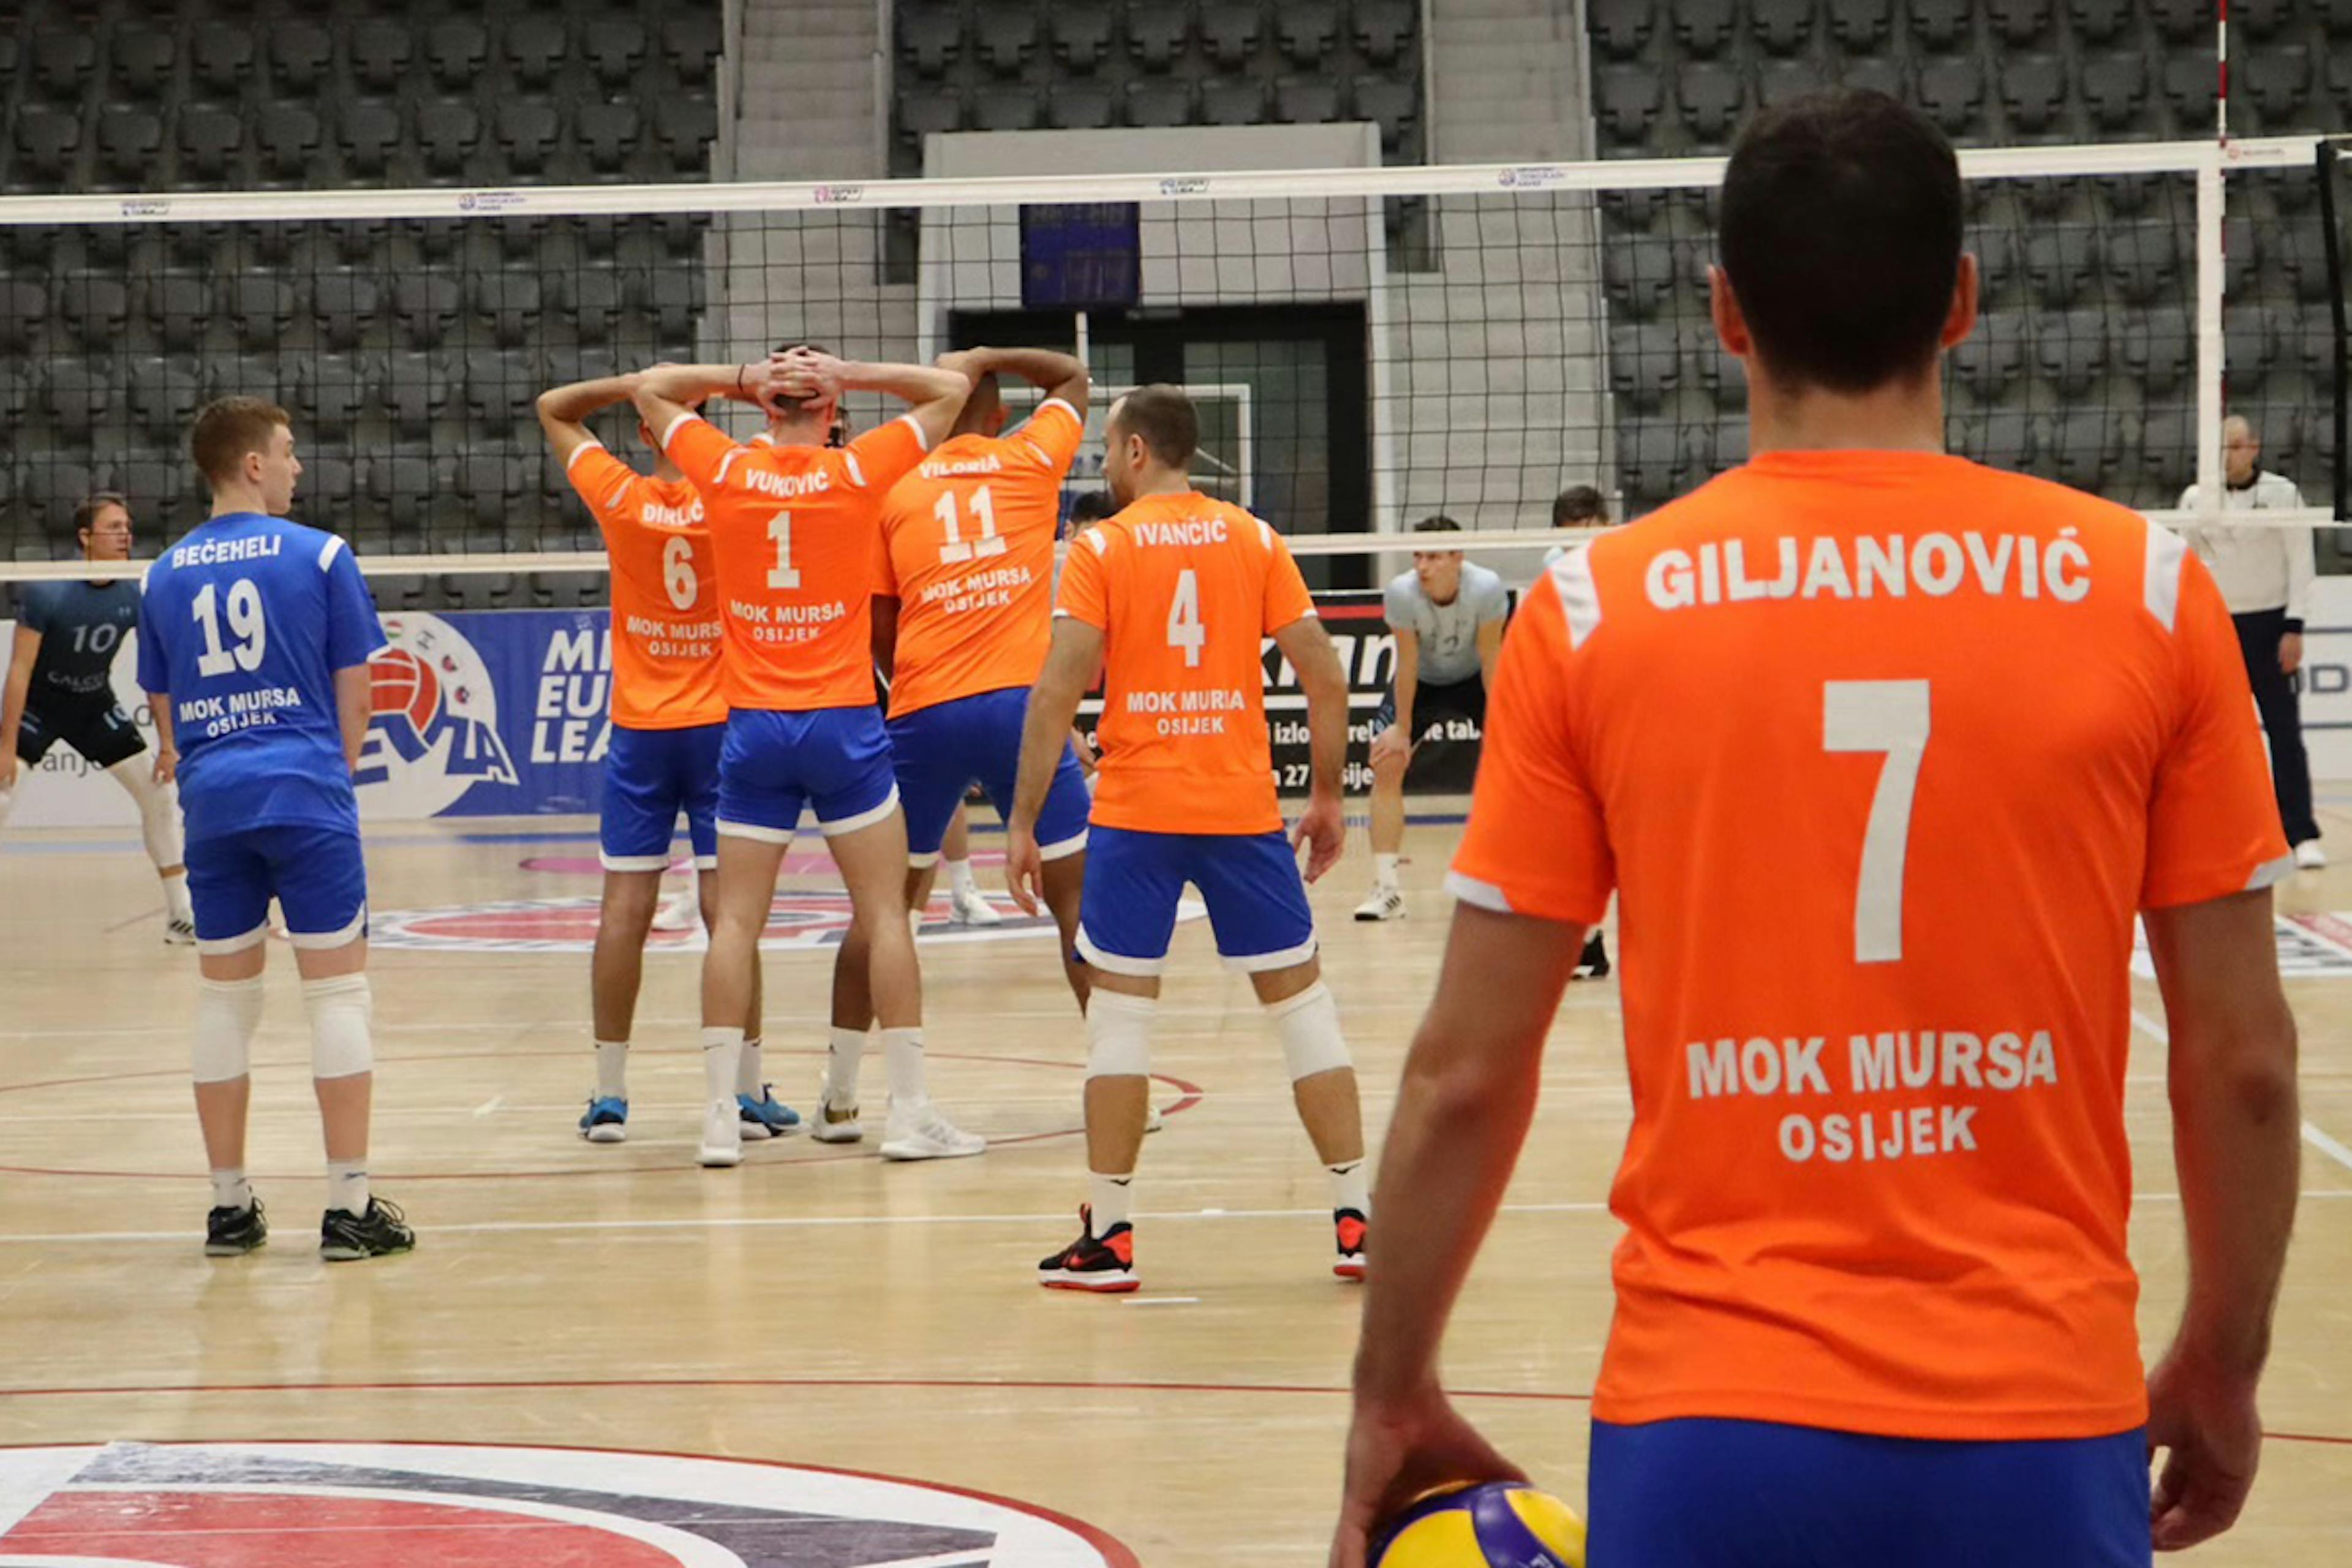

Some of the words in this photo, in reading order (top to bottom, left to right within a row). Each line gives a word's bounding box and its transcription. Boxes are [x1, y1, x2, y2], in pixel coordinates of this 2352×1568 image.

[745, 467, 829, 497] VUKOVIĆ
[934, 485, 1006, 565] 11
[1135, 514, 1227, 547] IVANČIĆ
[172, 534, 282, 569] BEČEHELI
[767, 510, 800, 588] 1
[663, 536, 697, 610] 6
[921, 578, 963, 603] MOK
[967, 566, 1031, 591] MURSA
[1645, 526, 2091, 610] GILJANOVIĆ
[730, 600, 769, 623] MOK
[775, 601, 846, 622] MURSA
[944, 589, 1011, 614] OSIJEK
[1167, 569, 1205, 667] 4
[73, 623, 118, 653] 10
[192, 578, 265, 677] 19
[627, 615, 666, 638] MOK
[753, 626, 821, 642] OSIJEK
[648, 640, 713, 657] OSIJEK
[179, 697, 225, 723] MOK
[228, 687, 301, 713] MURSA
[537, 674, 612, 718] EU
[1126, 691, 1177, 713] MOK
[206, 712, 277, 738] OSIJEK
[1157, 716, 1224, 736] OSIJEK
[1285, 764, 1310, 787] 27
[1823, 679, 1931, 963] 7
[1686, 1036, 1832, 1099] MOK
[1848, 1030, 2058, 1093] MURSA
[1778, 1105, 1978, 1162] OSIJEK
